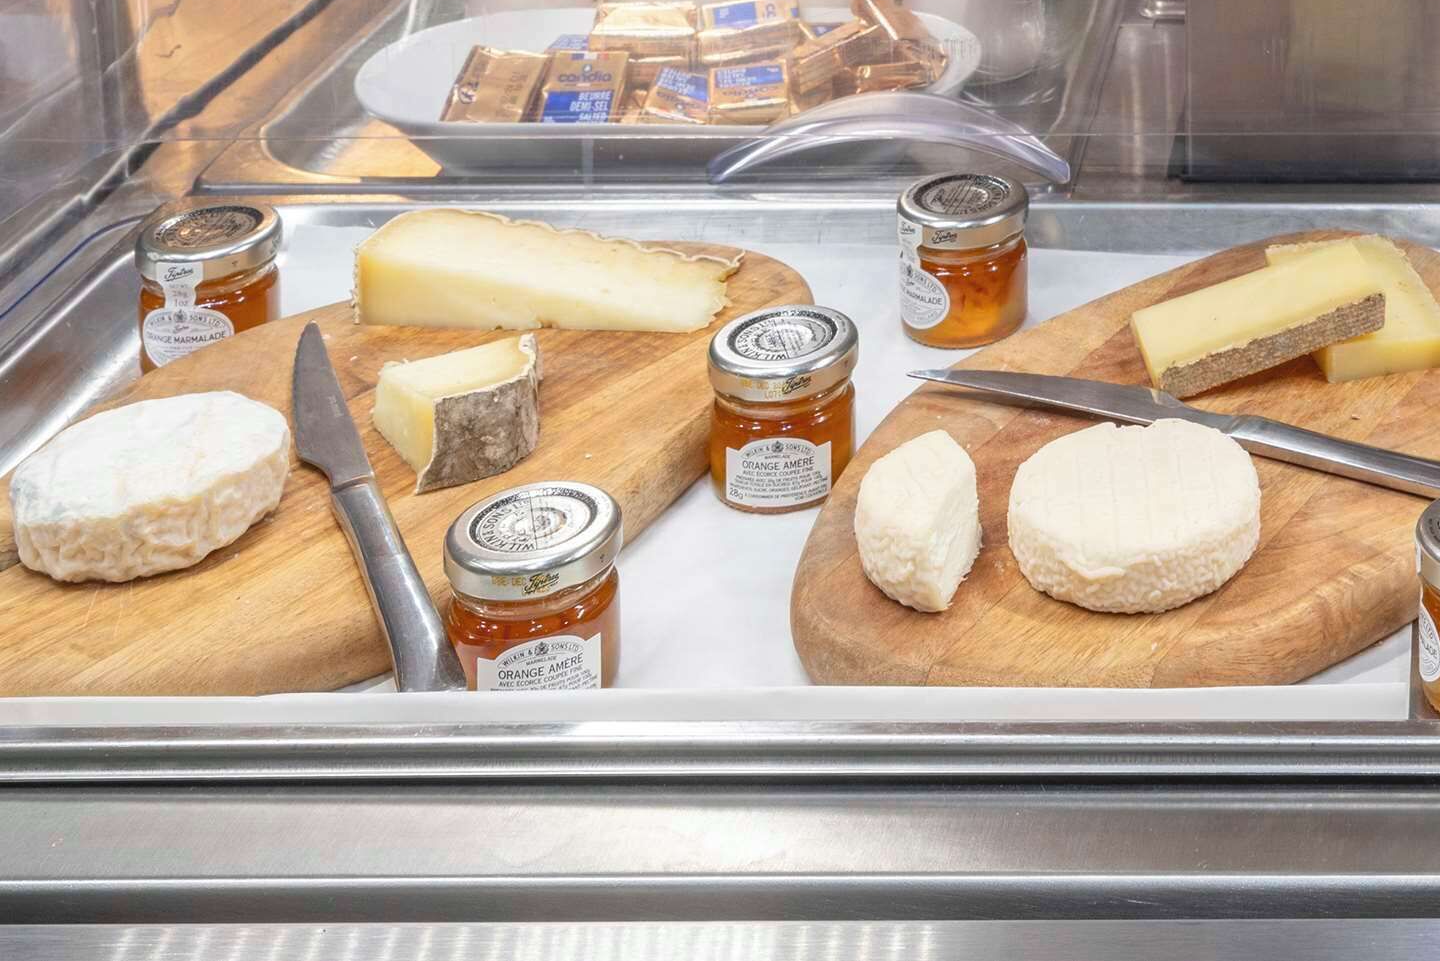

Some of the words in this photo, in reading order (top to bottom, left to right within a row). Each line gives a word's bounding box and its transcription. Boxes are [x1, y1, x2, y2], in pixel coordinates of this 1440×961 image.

[569, 101, 609, 112] DEMI-SEL
[174, 331, 226, 345] MARMALADE
[742, 460, 780, 471] ORANGE
[502, 651, 525, 667] WILKIN
[551, 641, 568, 651] SONS
[498, 666, 545, 680] ORANGE
[498, 680, 515, 688] AVEC
